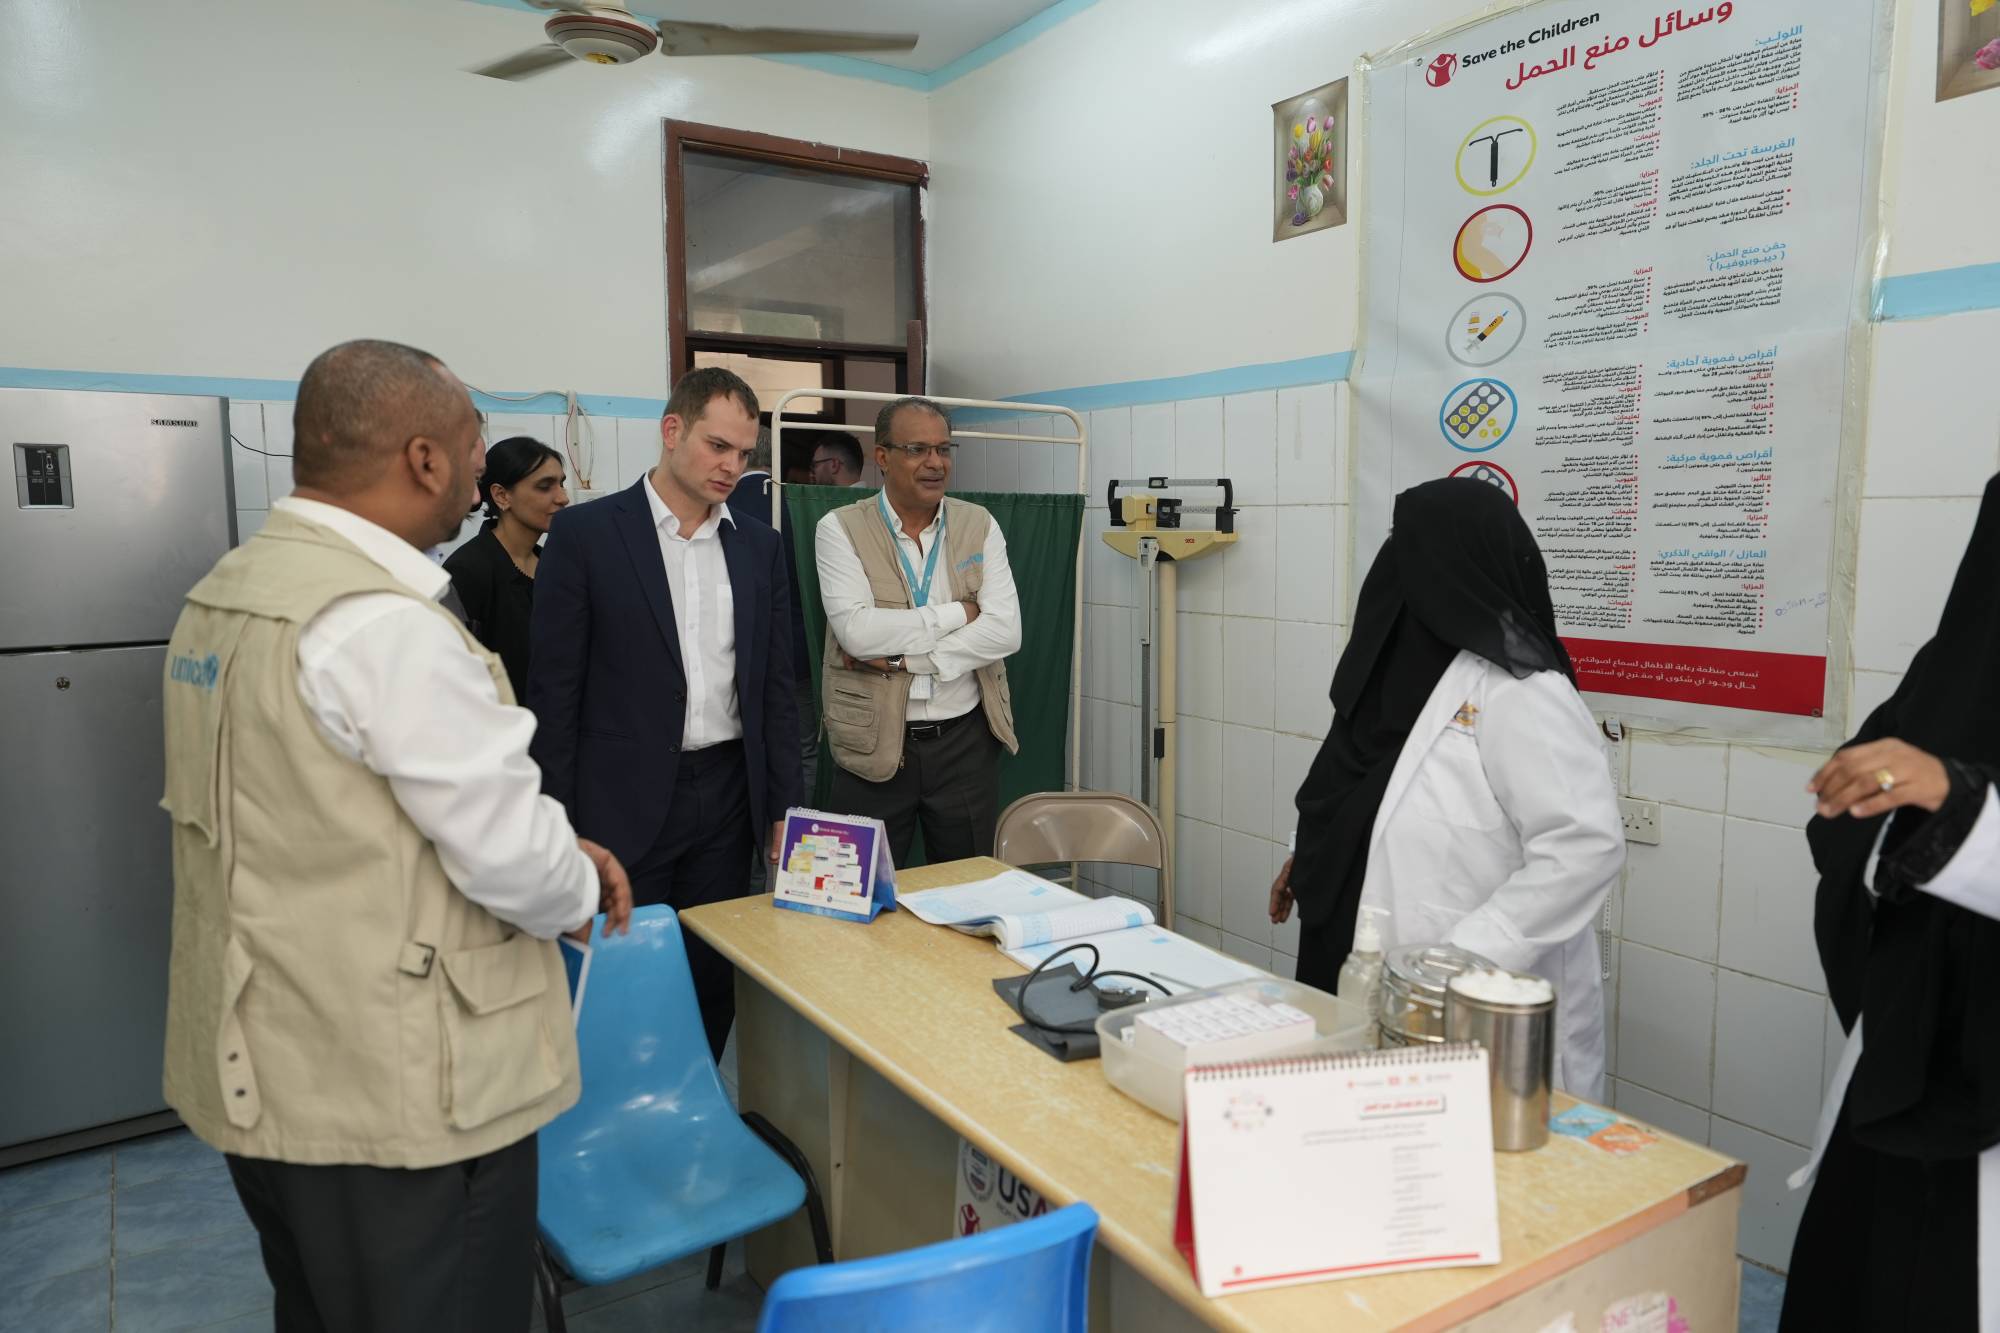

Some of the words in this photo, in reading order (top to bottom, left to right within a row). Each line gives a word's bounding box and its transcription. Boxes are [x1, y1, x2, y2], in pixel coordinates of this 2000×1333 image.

[1638, 1, 1733, 48] وسائل
[1462, 49, 1497, 68] Save
[1500, 39, 1526, 55] the
[1528, 12, 1600, 44] Children
[1583, 35, 1630, 70] منع
[1505, 45, 1576, 90] الحمل
[1751, 138, 1795, 154] الغرسة
[1722, 148, 1747, 161] تحت
[1691, 154, 1719, 169] الجلد:
[1707, 248, 1739, 262] الحمل:
[1741, 247, 1760, 256] منع
[1702, 354, 1735, 365] فموية
[1738, 346, 1777, 362] أقراص
[1667, 355, 1699, 368] أحادية:
[151, 419, 198, 427] SAMSUNG
[1667, 454, 1696, 463] مركبة:
[1699, 454, 1732, 462] فموية
[1736, 448, 1772, 461] أقراص
[1659, 549, 1690, 559] الذكري:
[1692, 550, 1726, 560] الواقي
[1736, 550, 1766, 560] العازل
